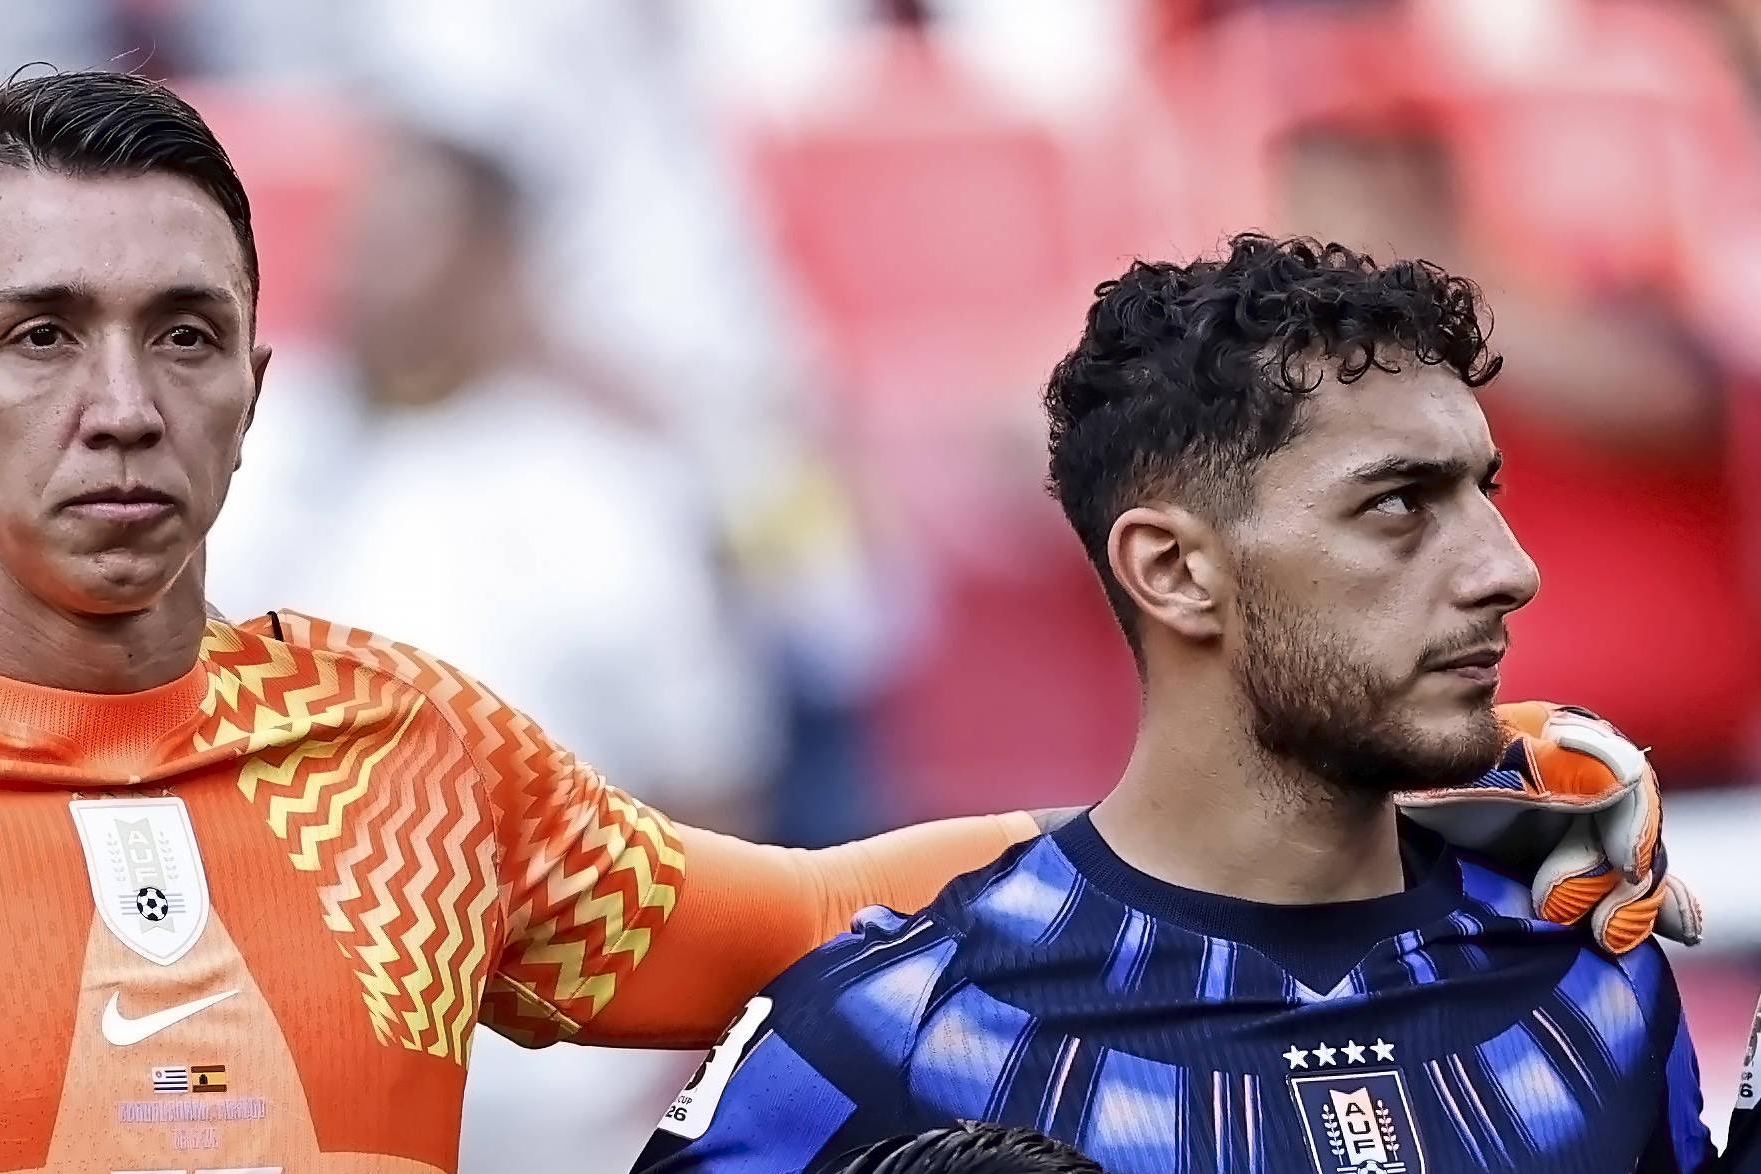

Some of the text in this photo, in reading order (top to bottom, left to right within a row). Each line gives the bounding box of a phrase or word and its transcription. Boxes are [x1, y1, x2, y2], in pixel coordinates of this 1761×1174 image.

[128, 830, 158, 883] AUF
[665, 1105, 688, 1122] 26
[1345, 1102, 1376, 1155] AUF
